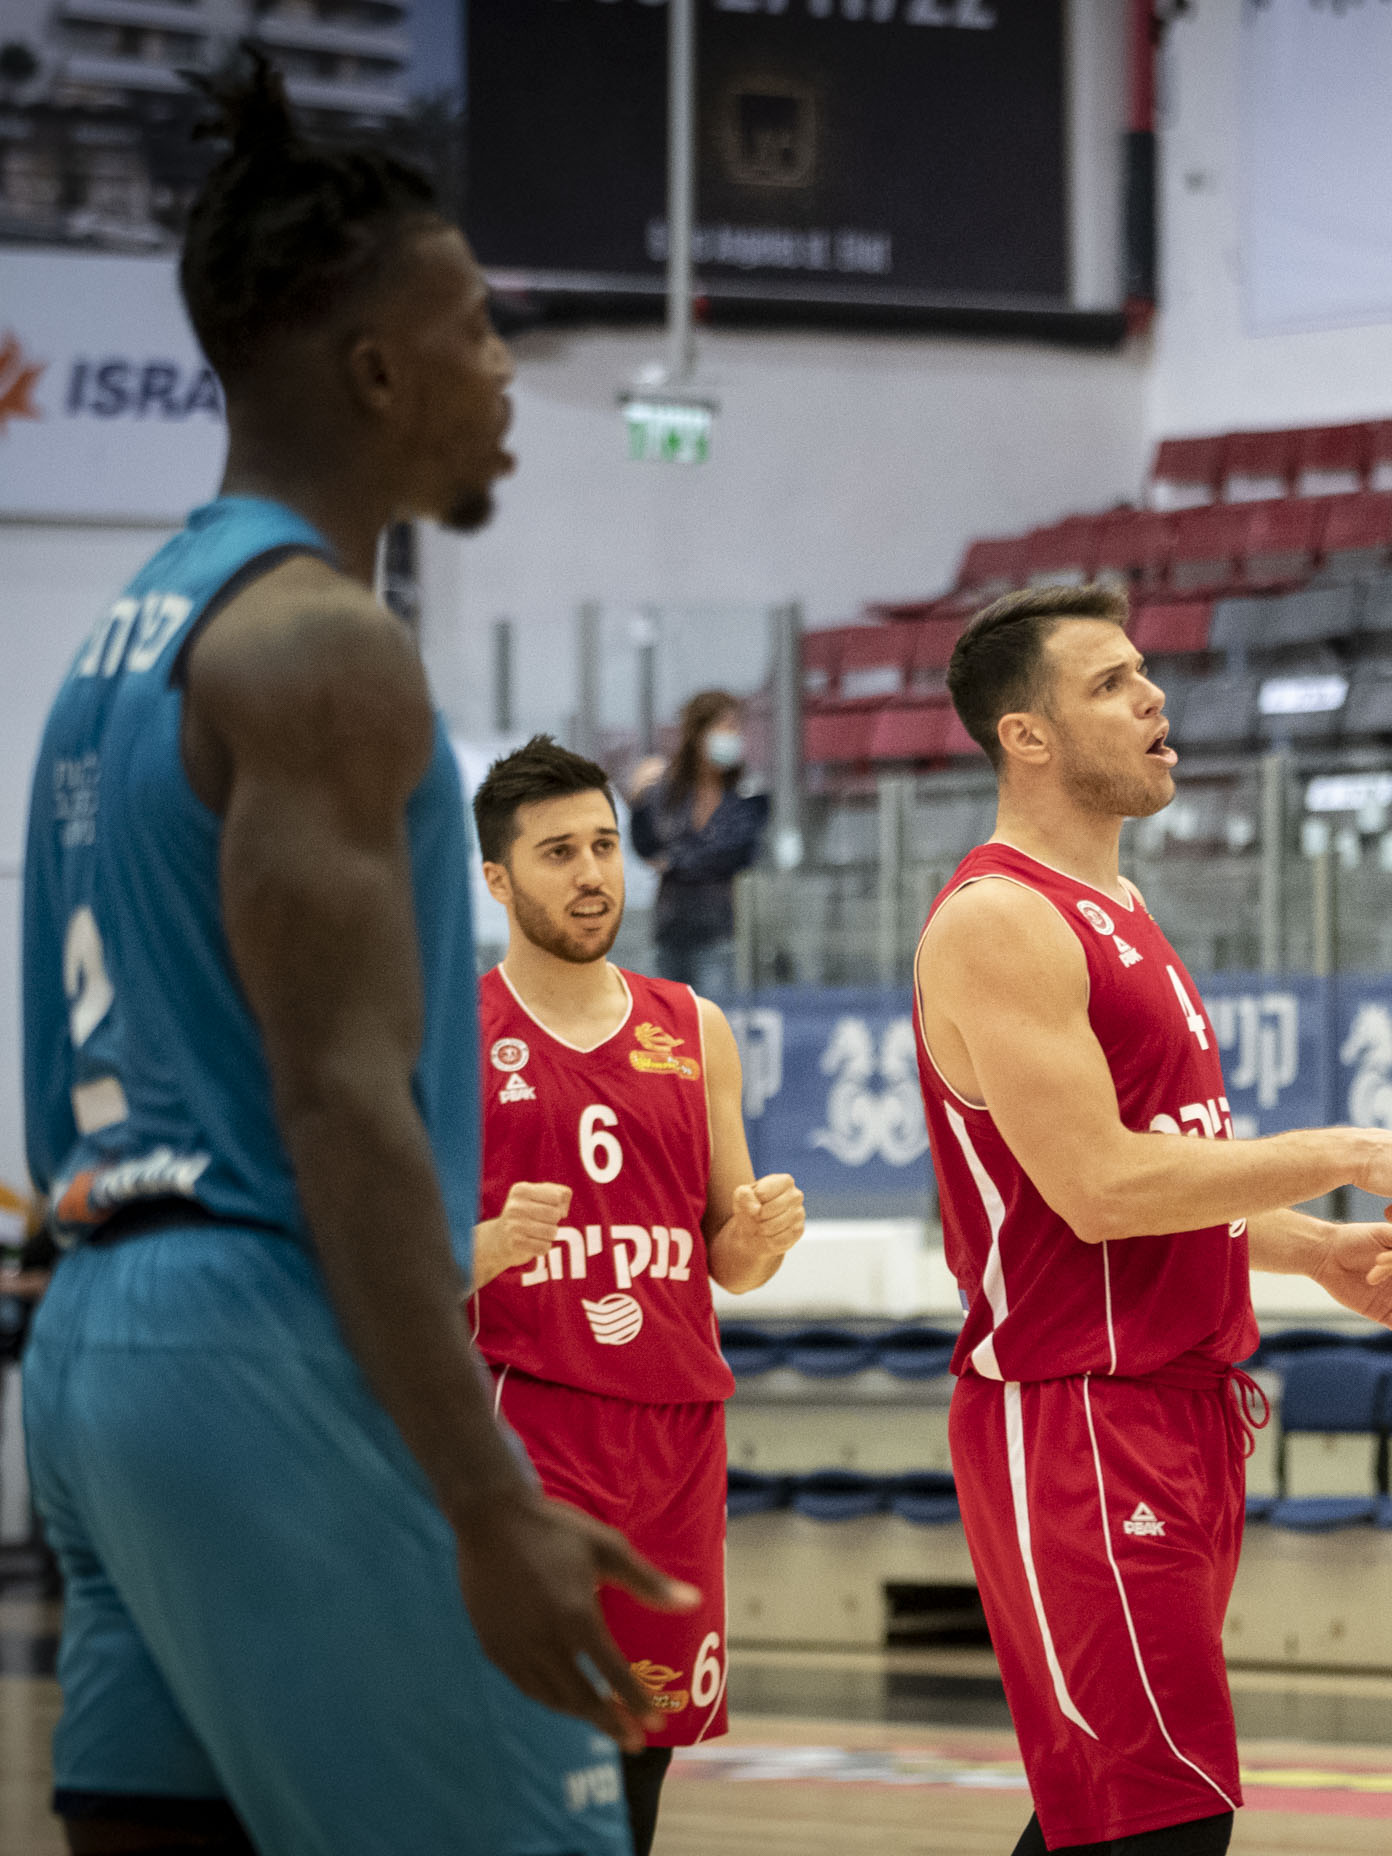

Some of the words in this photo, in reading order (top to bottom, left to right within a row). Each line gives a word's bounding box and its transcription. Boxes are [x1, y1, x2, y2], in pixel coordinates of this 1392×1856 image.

[66, 357, 221, 420] ISRA
[1165, 964, 1209, 1051] 4
[578, 1103, 624, 1184] 6
[1123, 1520, 1166, 1537] PEAK
[691, 1631, 720, 1708] 6
